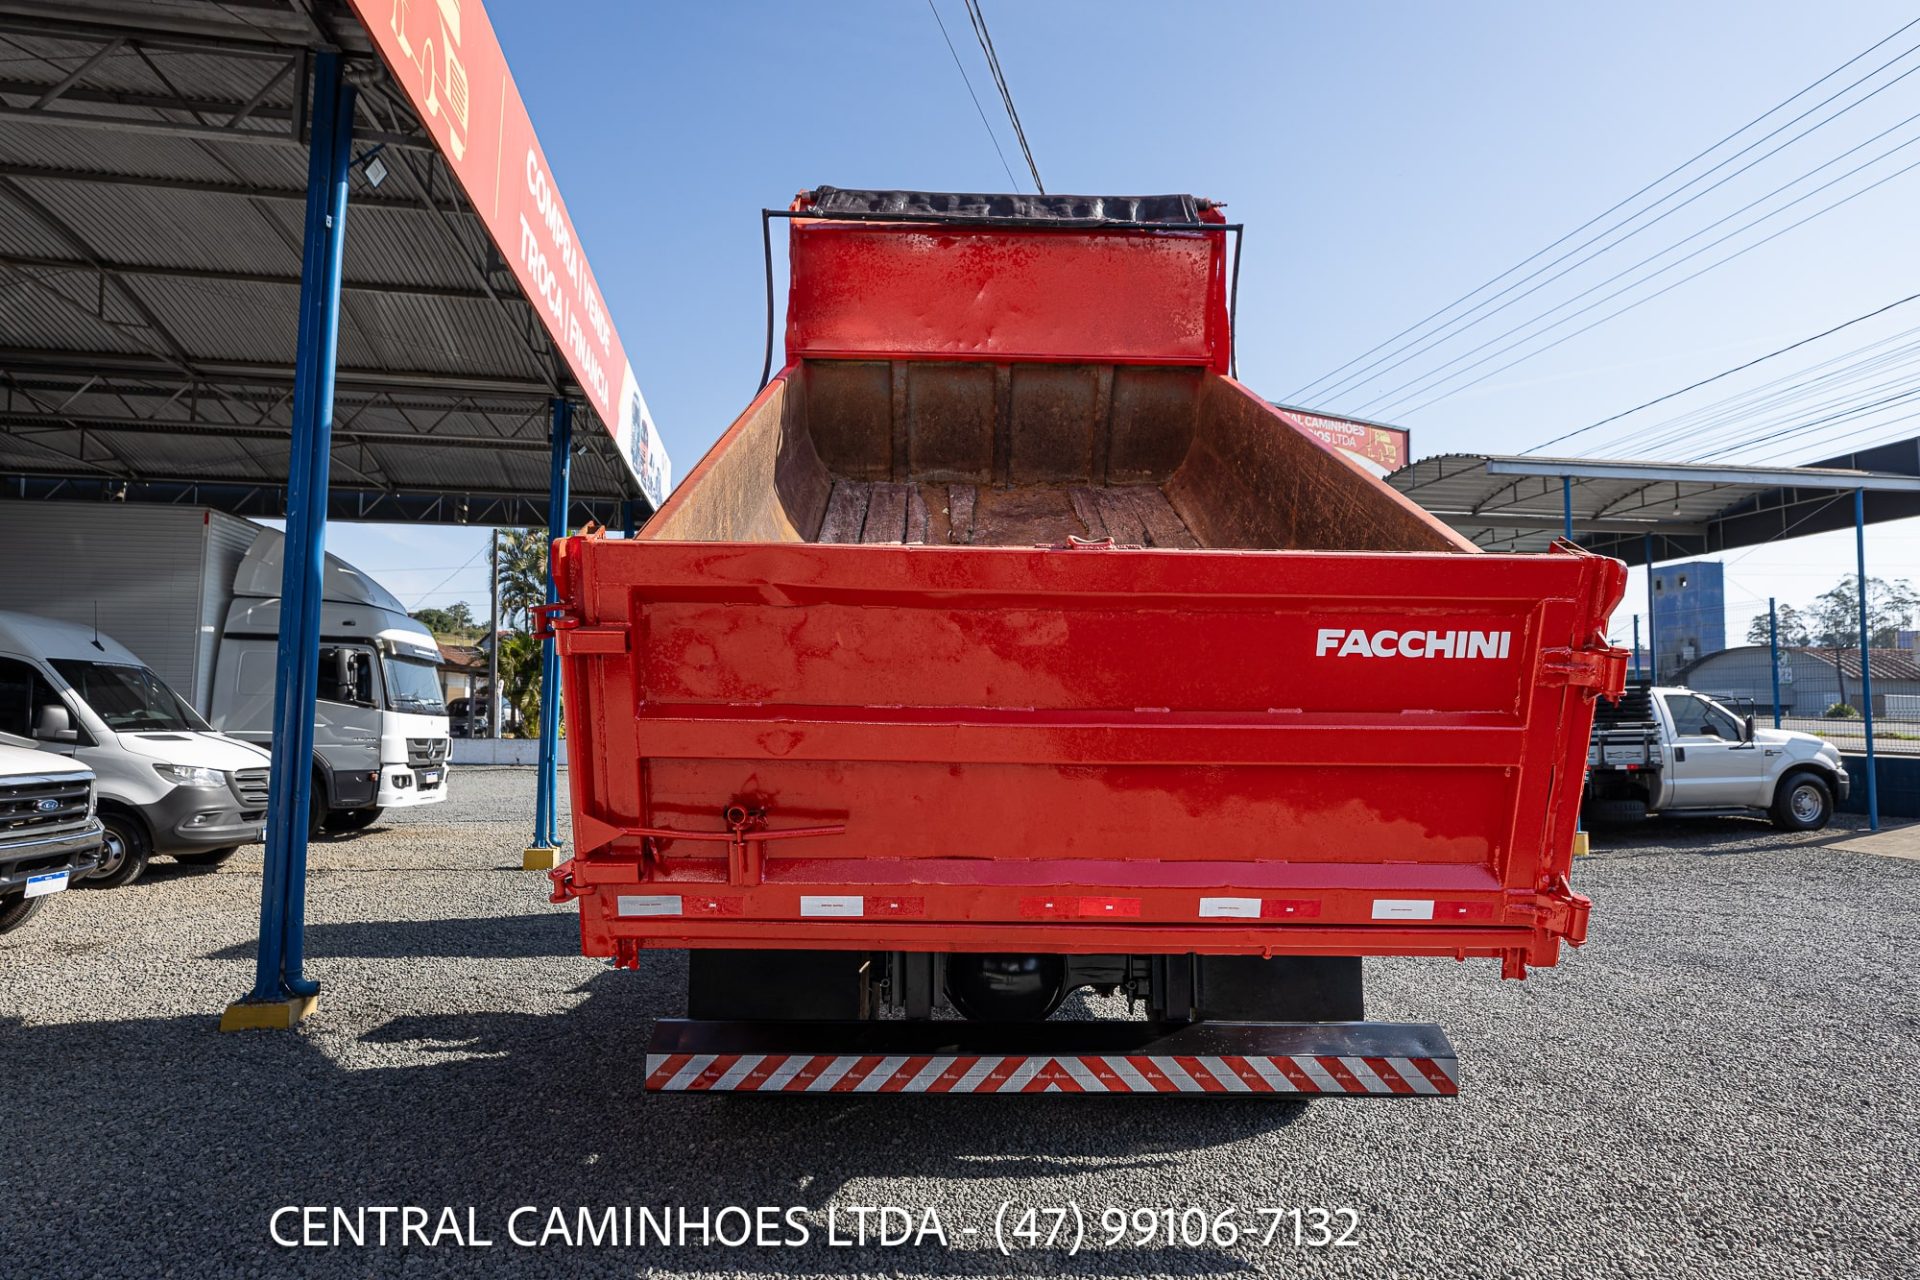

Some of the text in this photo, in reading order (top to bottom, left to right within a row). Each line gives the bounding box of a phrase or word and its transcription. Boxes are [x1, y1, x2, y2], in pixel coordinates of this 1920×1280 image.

[526, 147, 578, 288] COMPRA
[583, 273, 611, 358] VENDE
[519, 211, 563, 329] TROCA
[569, 311, 609, 412] FINANCIA
[1304, 416, 1366, 437] CAMINHÕES
[1331, 433, 1357, 447] LTDA
[1316, 629, 1511, 659] FACCHINI
